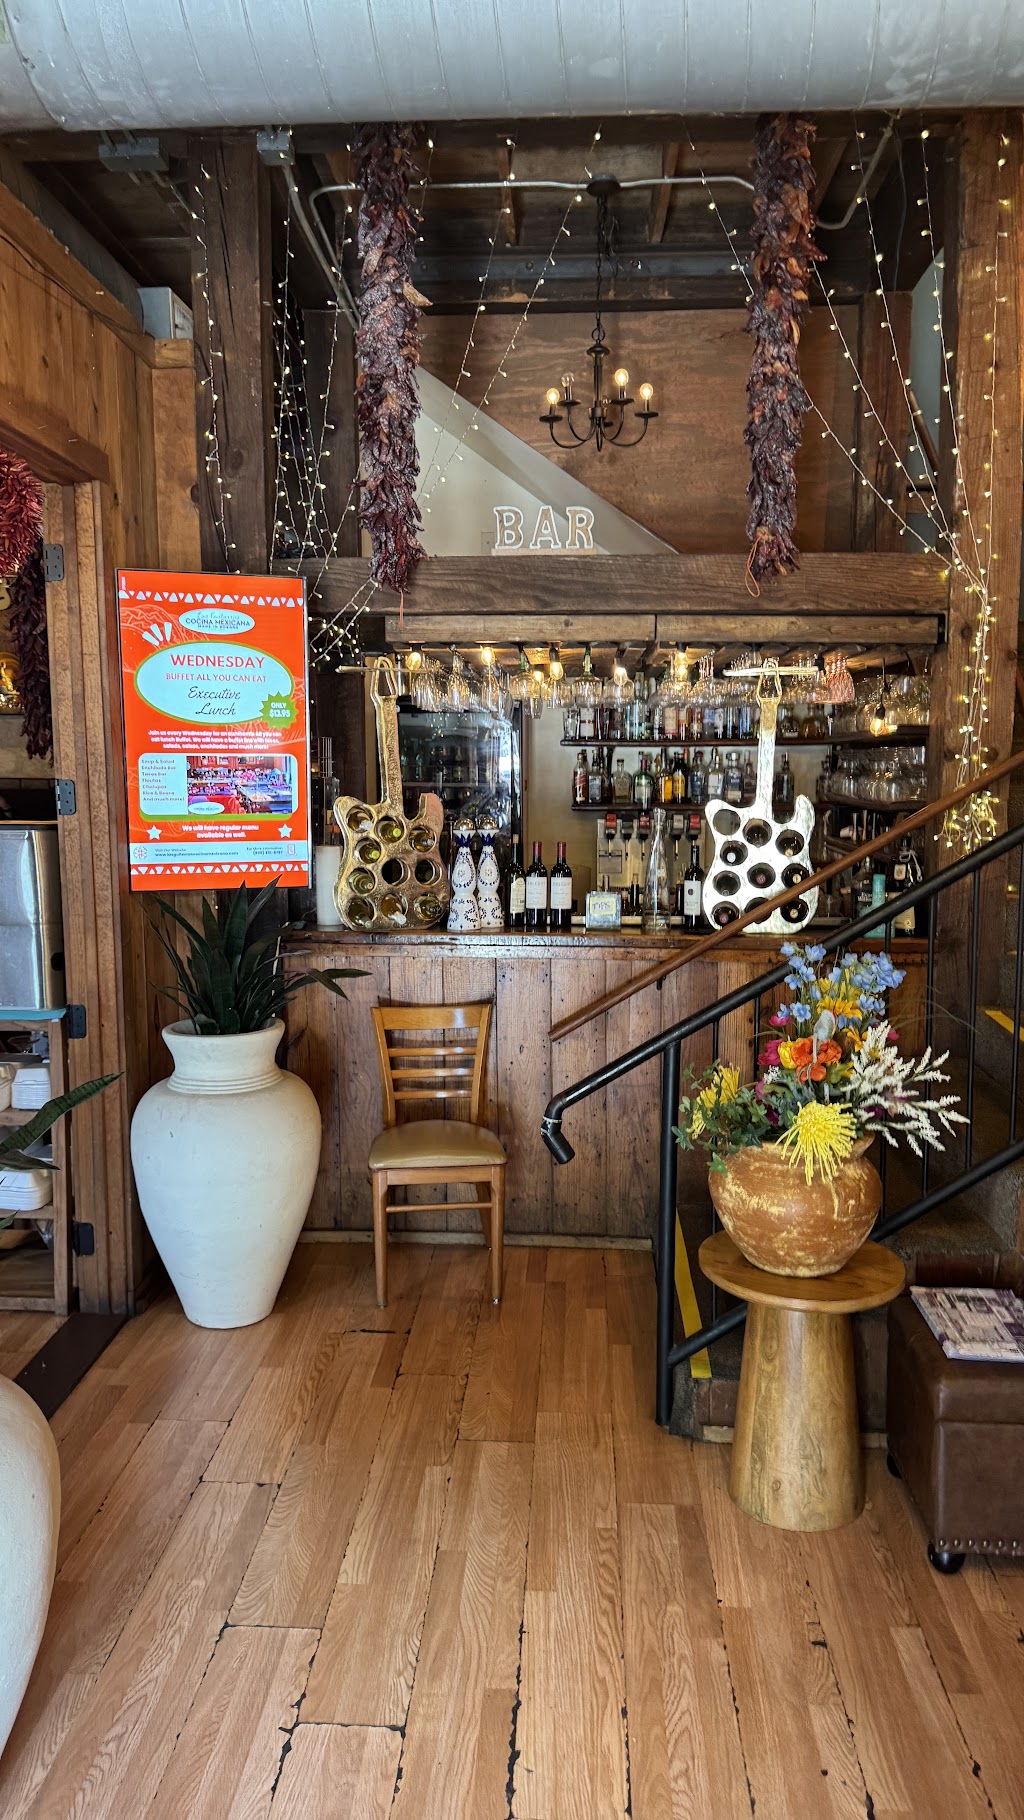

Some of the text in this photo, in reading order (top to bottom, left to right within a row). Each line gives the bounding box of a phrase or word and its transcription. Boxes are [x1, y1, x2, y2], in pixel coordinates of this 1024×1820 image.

[493, 505, 594, 549] BAR
[170, 654, 265, 668] WEDNESDAY
[188, 686, 240, 700] Executive
[195, 702, 236, 716] Lunch
[592, 901, 610, 910] TIPS
